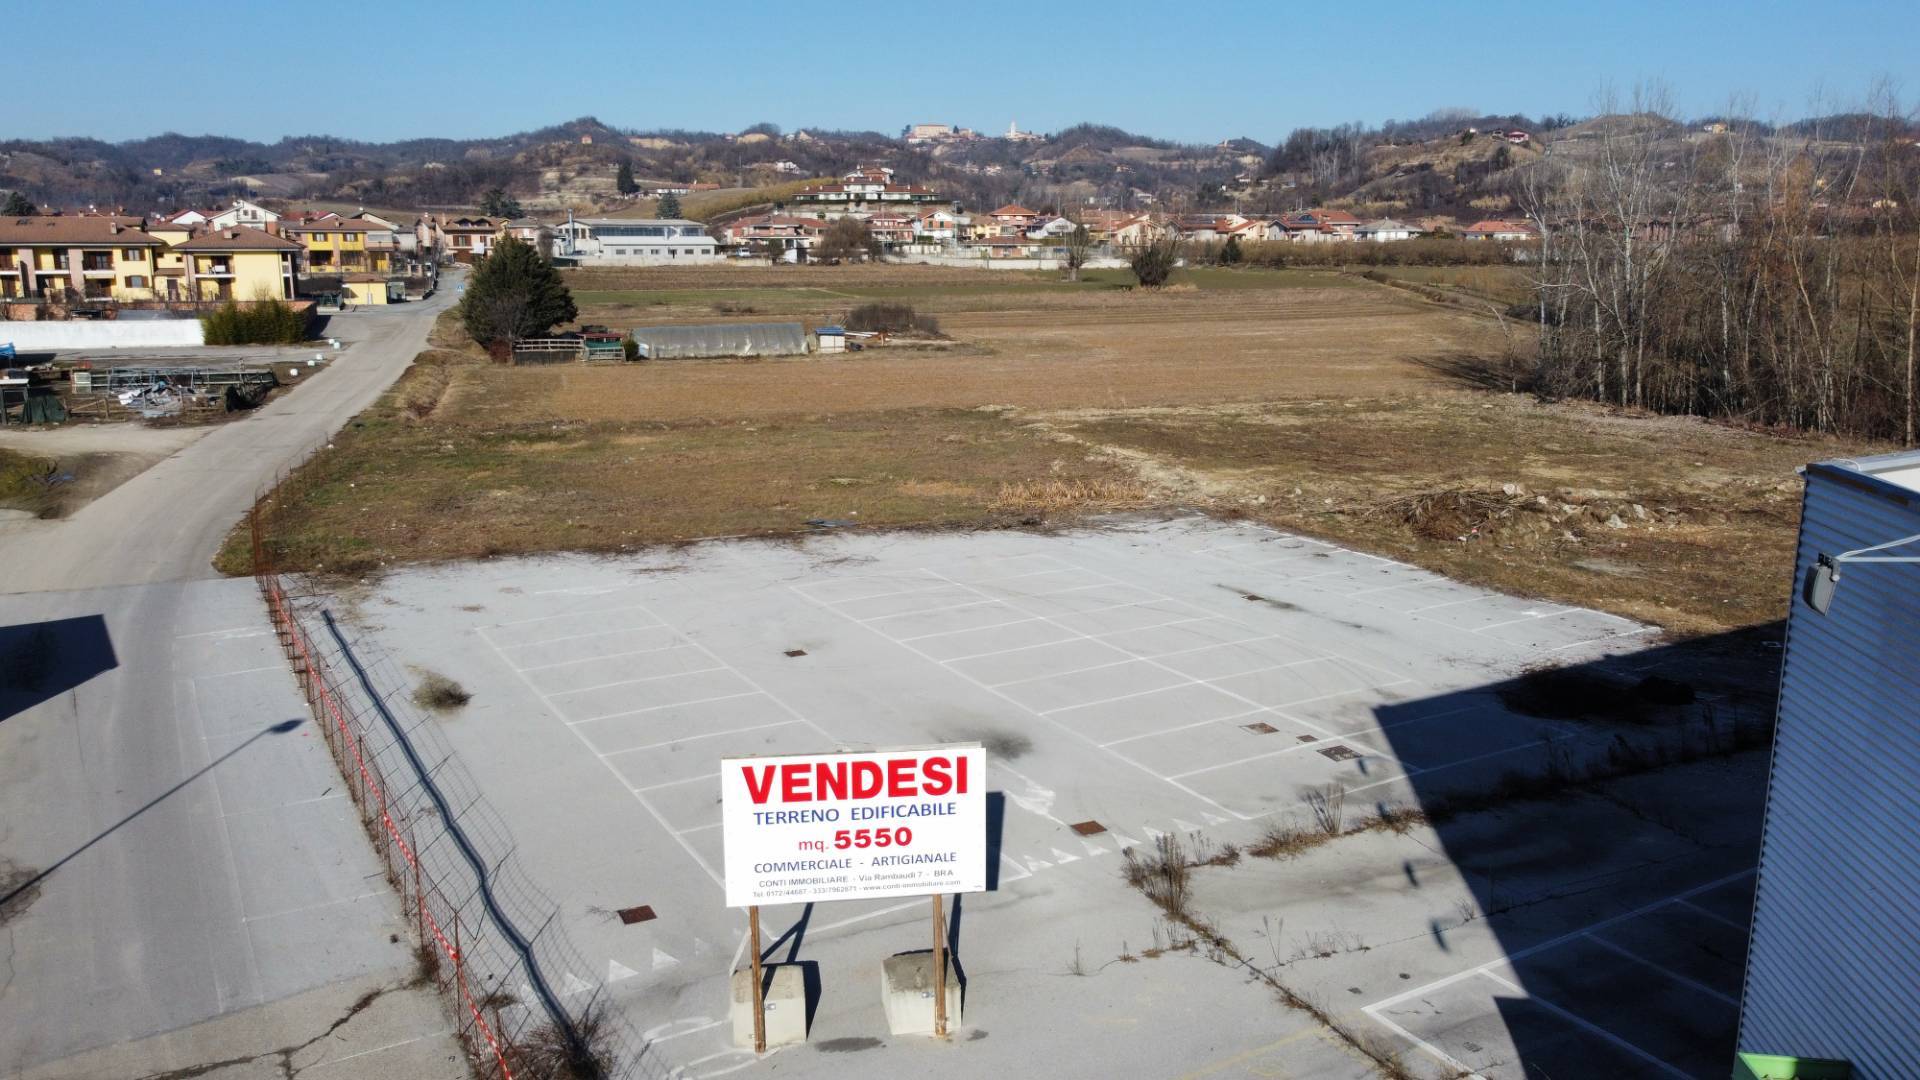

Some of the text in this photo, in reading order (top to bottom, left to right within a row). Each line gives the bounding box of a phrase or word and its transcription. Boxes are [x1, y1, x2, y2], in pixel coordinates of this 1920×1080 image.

[741, 756, 968, 804] VENDESI
[754, 802, 957, 825] TERRENO EDIFICABILE
[798, 827, 912, 852] mq. 5550
[754, 858, 852, 873] COMMERCIALE
[871, 852, 957, 867] ARTIGIANALE
[759, 879, 787, 888] CONTI
[788, 875, 848, 886] IMMOBILIARE
[859, 873, 872, 881] Via
[874, 871, 916, 881] Rambaudi
[933, 869, 954, 877] BRA
